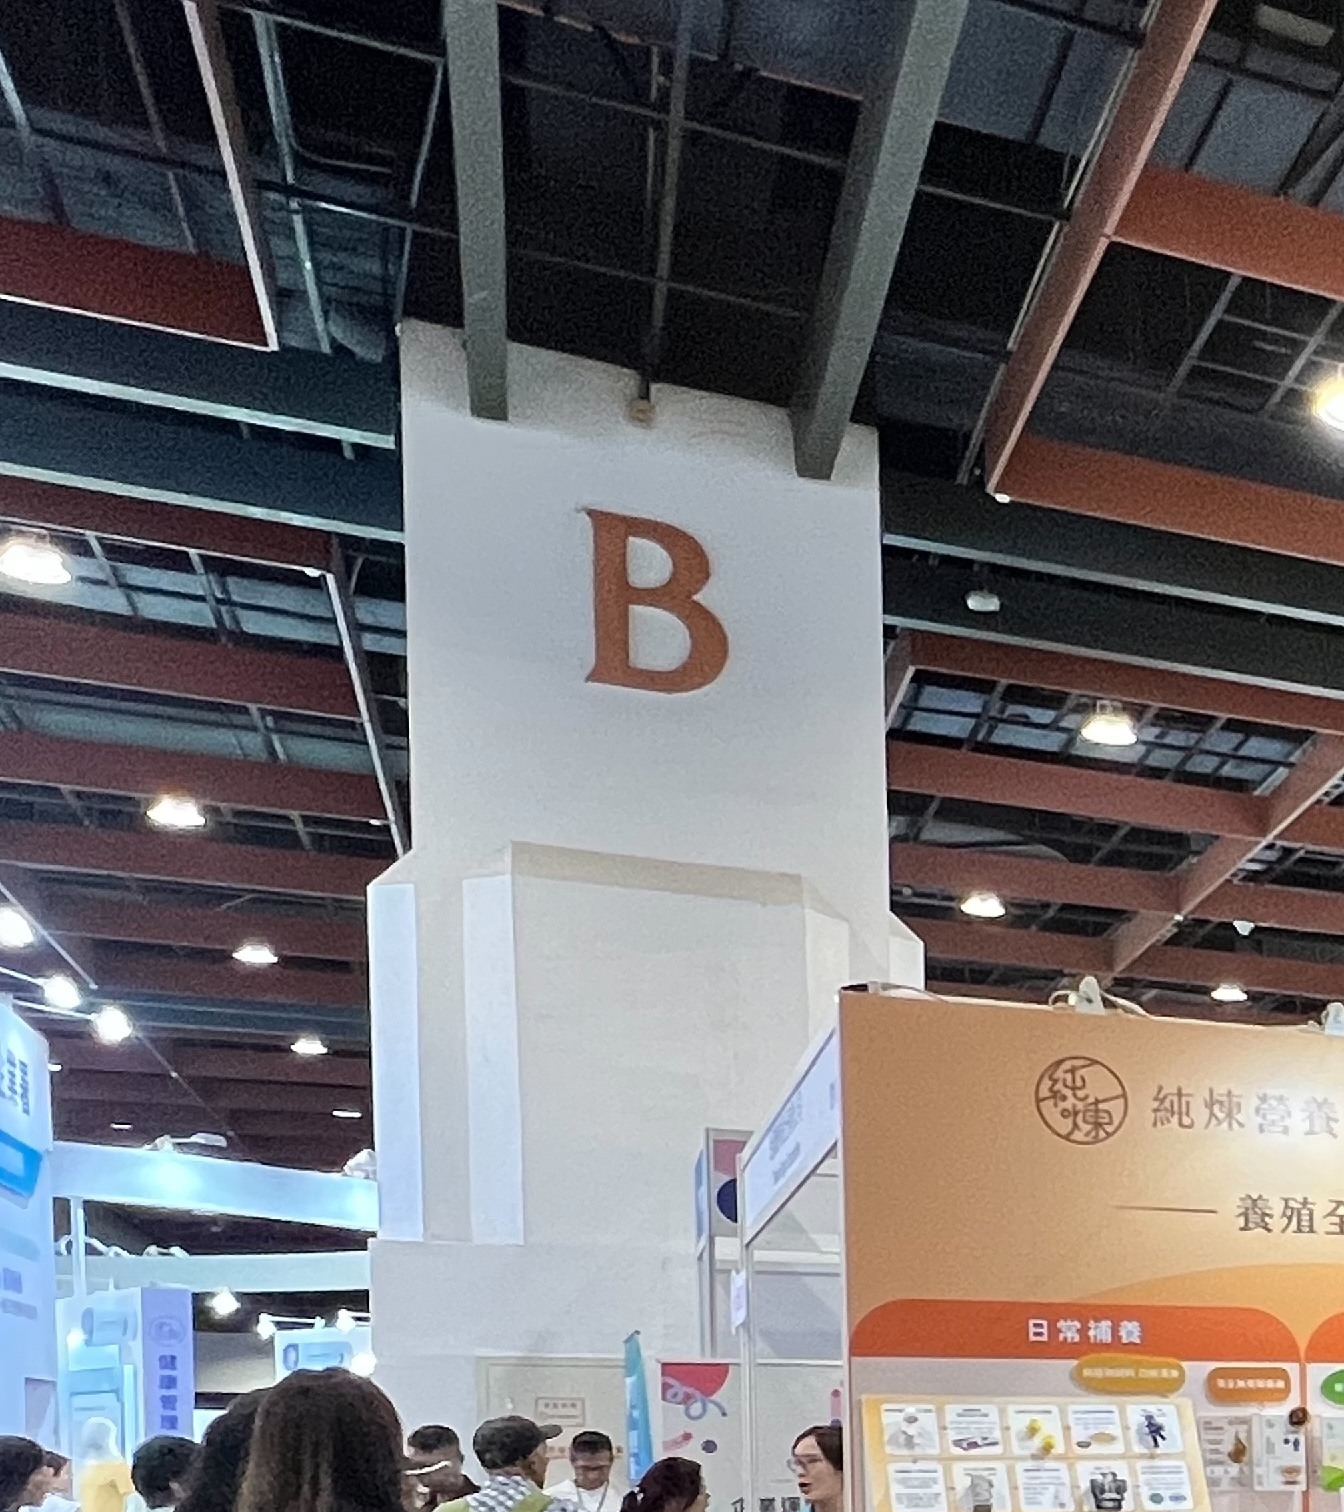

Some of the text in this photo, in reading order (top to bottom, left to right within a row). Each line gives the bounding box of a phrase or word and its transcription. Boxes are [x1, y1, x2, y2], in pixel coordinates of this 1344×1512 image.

[580, 508, 729, 694] B
[1028, 1318, 1142, 1344] 日常補養
